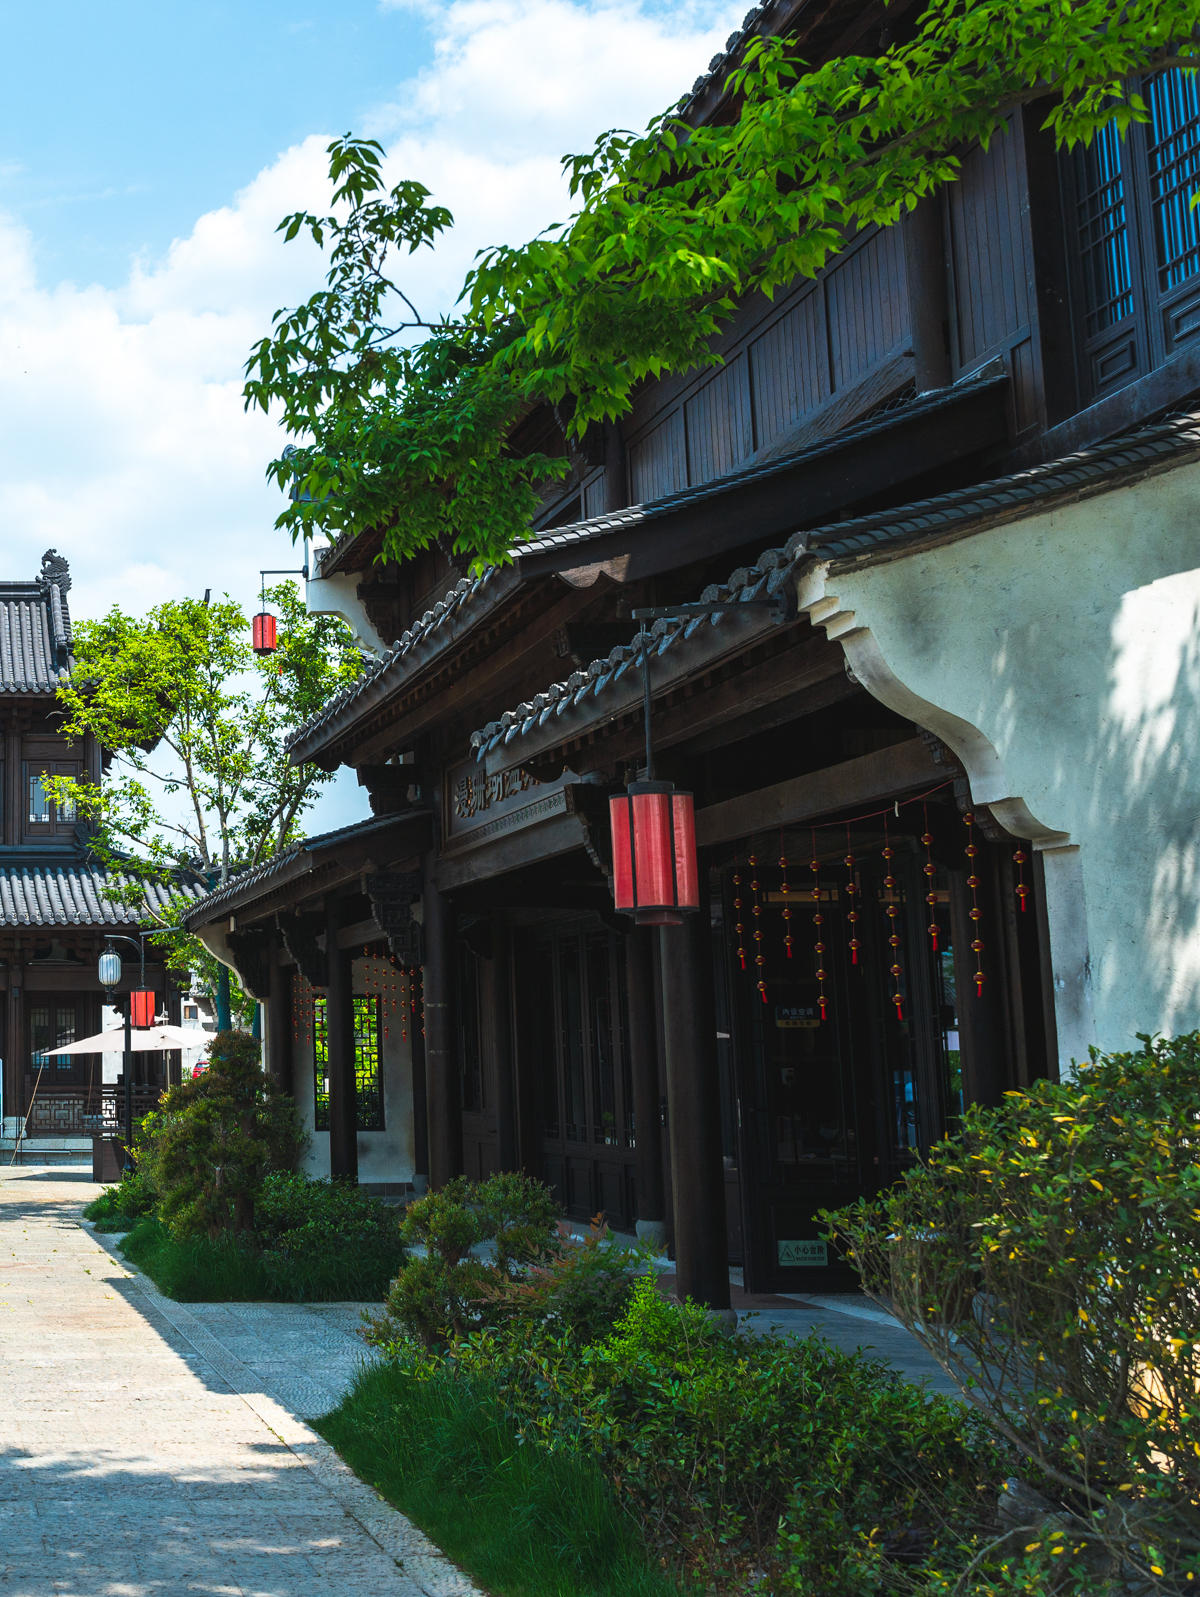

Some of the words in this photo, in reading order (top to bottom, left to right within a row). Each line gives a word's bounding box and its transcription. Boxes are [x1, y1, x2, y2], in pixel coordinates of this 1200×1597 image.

[782, 1007, 813, 1016] 内设空调
[794, 1245, 824, 1254] 小心台阶
